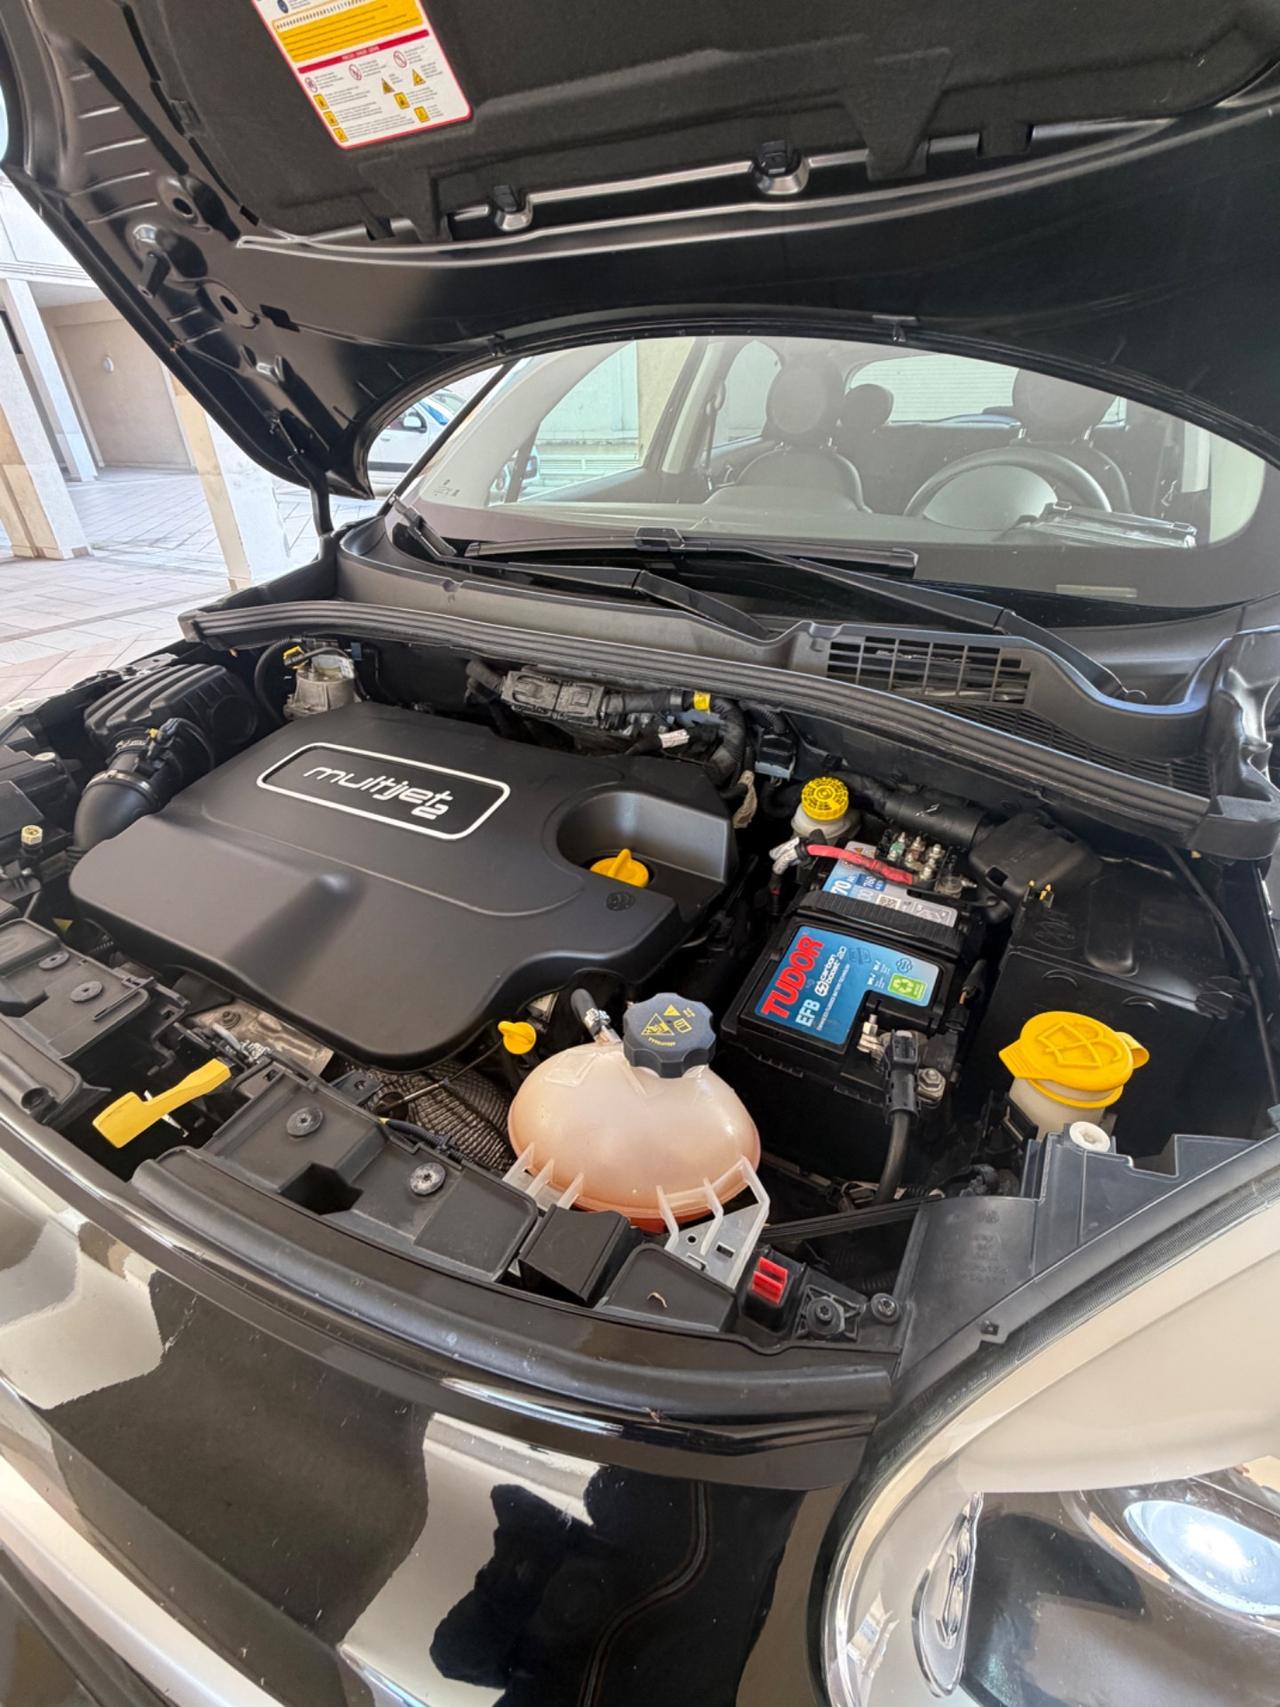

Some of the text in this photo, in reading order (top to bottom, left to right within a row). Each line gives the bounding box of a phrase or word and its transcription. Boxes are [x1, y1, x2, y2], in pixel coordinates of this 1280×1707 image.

[303, 767, 453, 806] multijet
[761, 935, 824, 1018] TUDOR
[796, 999, 820, 1027] EFB
